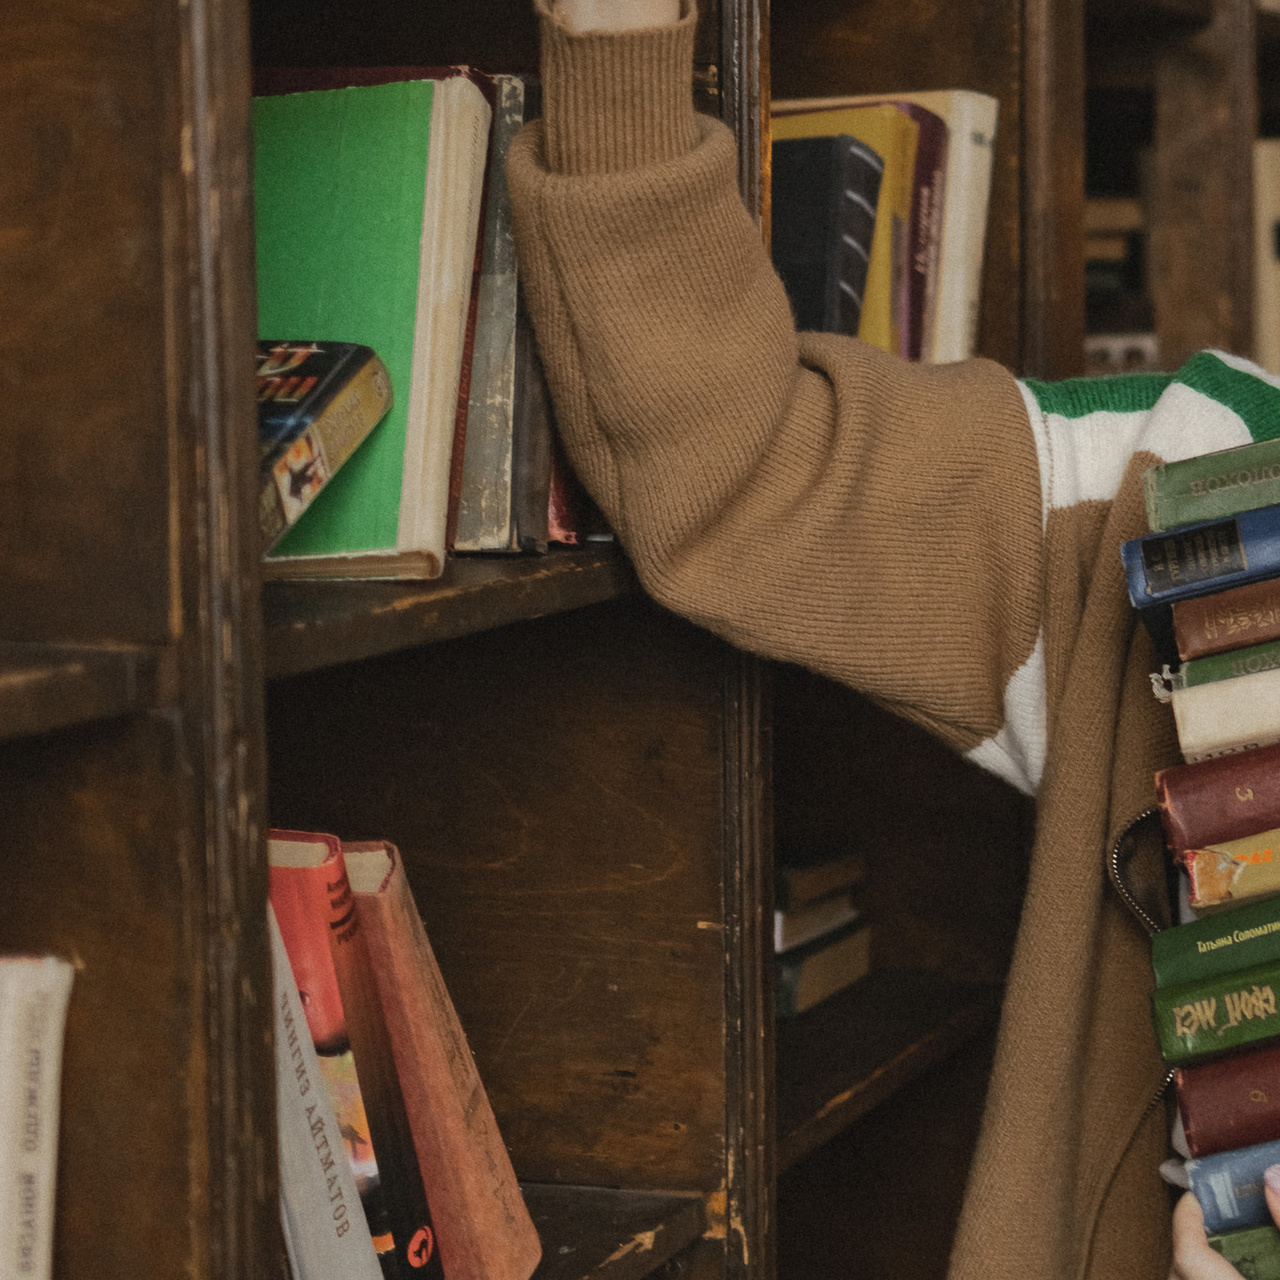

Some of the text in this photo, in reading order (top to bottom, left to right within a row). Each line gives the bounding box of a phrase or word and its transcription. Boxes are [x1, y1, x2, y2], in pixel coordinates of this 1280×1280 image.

[1196, 934, 1234, 954] Татьяна
[278, 990, 351, 1240] ЧИНГИЗ АЙТМАТОВ
